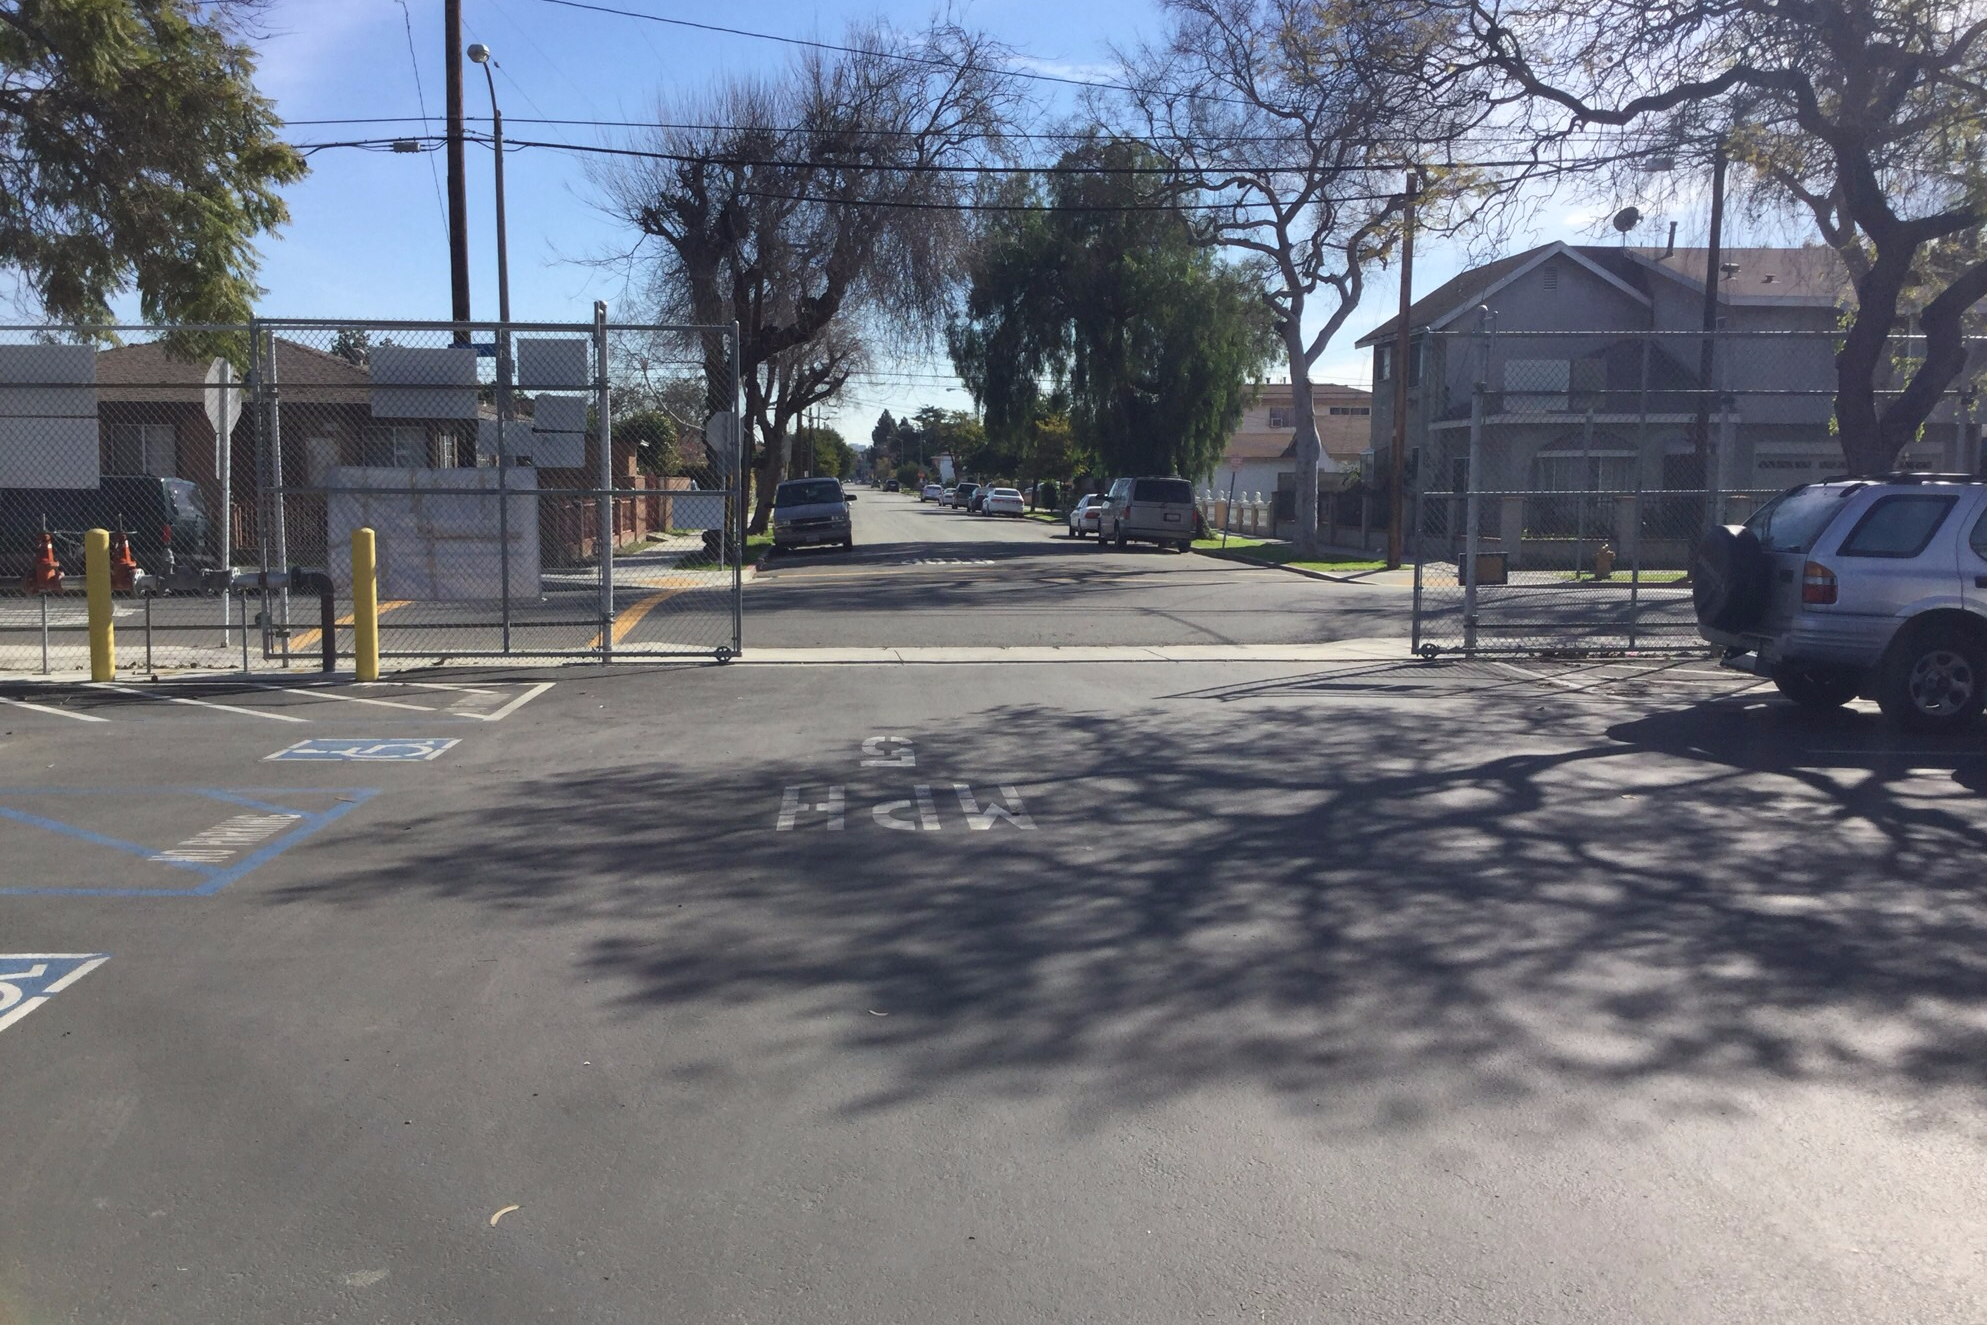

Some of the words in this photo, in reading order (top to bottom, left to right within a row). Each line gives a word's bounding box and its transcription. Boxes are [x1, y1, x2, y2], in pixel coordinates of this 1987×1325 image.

[860, 736, 917, 767] 5
[776, 784, 1038, 831] MPH
[147, 849, 238, 863] NO
